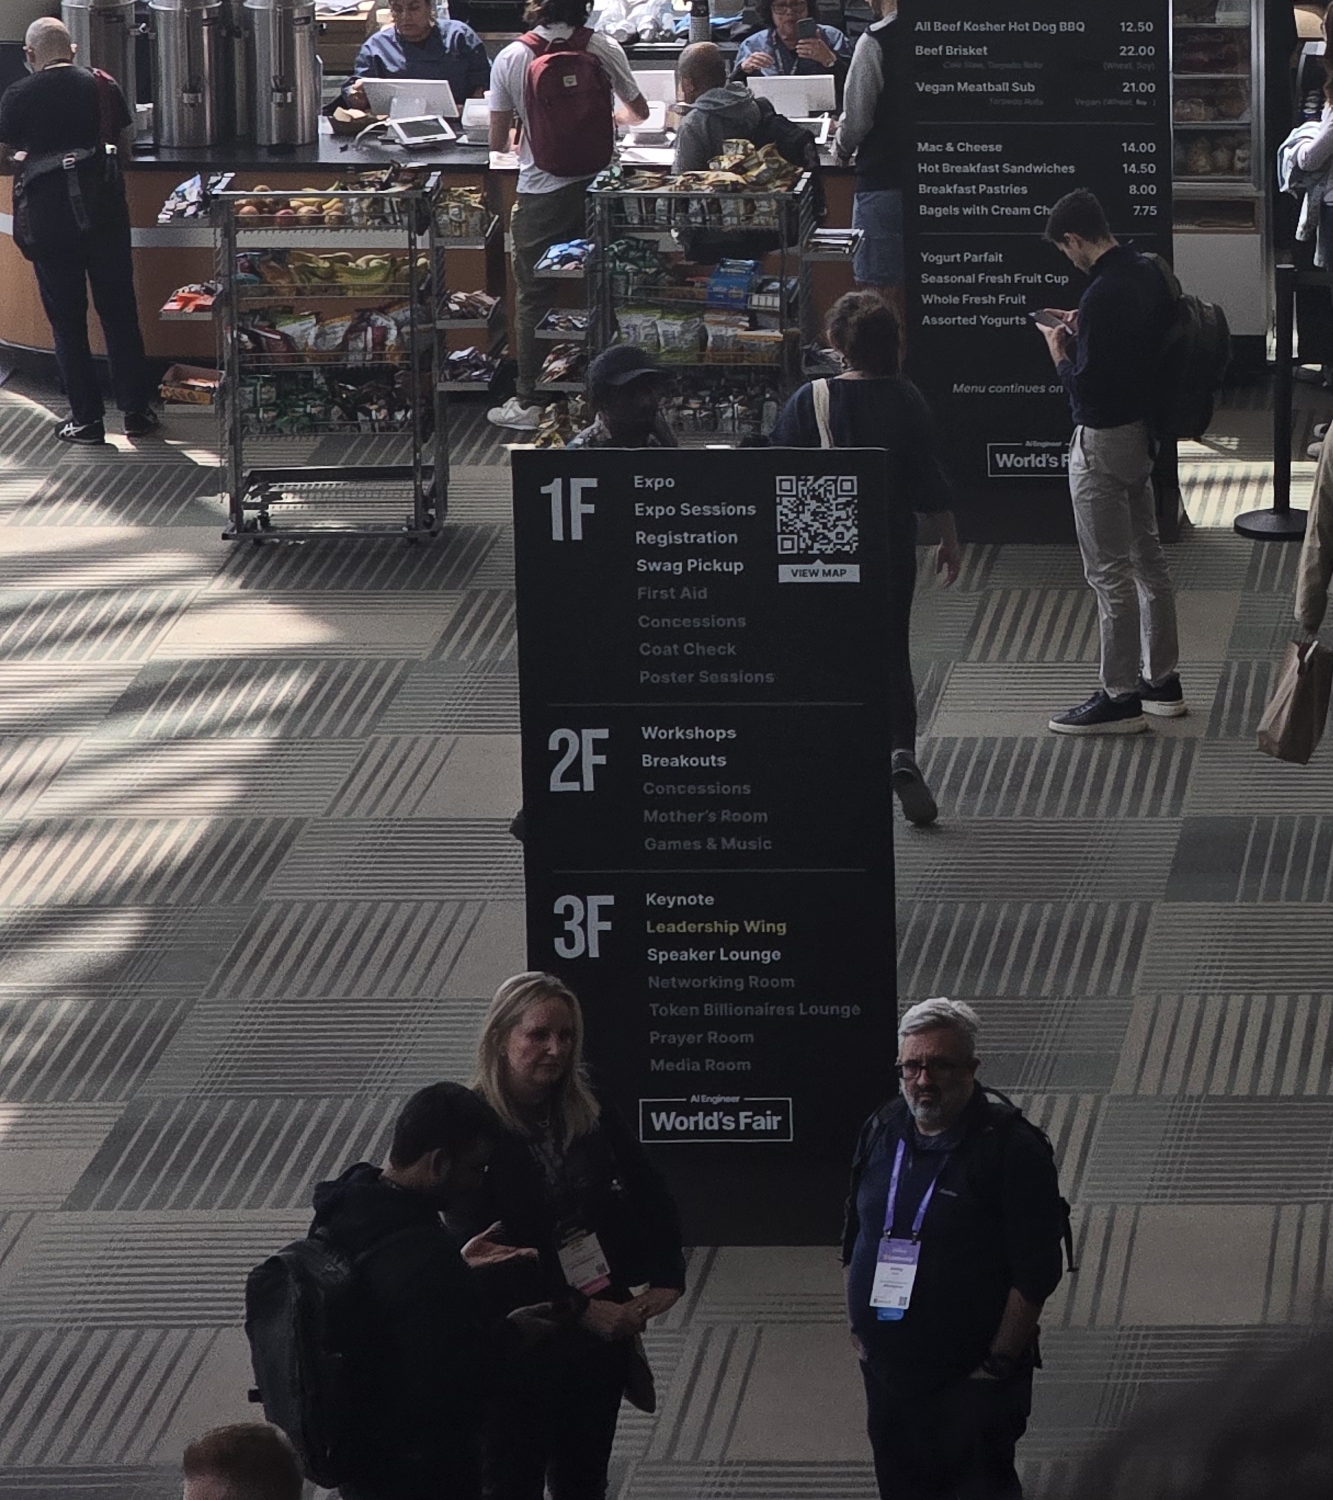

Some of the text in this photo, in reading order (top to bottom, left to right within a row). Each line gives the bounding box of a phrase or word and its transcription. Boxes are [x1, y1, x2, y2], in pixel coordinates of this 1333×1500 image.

[915, 21, 1085, 34] All Beef Kosher Hot Dog BBQ
[1120, 22, 1153, 32] 12.50
[916, 45, 987, 55] Beef Brisket
[1120, 46, 1155, 56] 22.00
[915, 82, 1035, 94] Vegan Meatball Sub
[1123, 82, 1155, 92] 21.00
[917, 142, 1002, 151] Mac & Cheese
[1122, 143, 1156, 152] 14.00
[918, 163, 1075, 173] Hot Breakfast Sandwiches
[1123, 164, 1156, 173] 14.50
[919, 184, 1027, 194] Breakfast Pastries
[1129, 185, 1156, 194] 8.00
[920, 205, 959, 217] Bagels
[962, 205, 988, 215] with
[991, 205, 1030, 215] Cream
[1133, 206, 1157, 215] 7.75
[921, 252, 1002, 264] Yogurt Parfait
[921, 273, 1069, 285] Seasonal Fresh Fruit Cup
[921, 294, 1026, 304] Whole Fresh Fruit
[922, 315, 1026, 327] Assorted Yogurts
[953, 383, 1063, 393] Menu continues on
[996, 454, 1058, 467] World's
[634, 476, 674, 490] Expo
[541, 478, 598, 541] 1F
[635, 502, 756, 519] Expo Sessions
[636, 531, 737, 547] Registration
[637, 558, 743, 575] Swag Pickup
[791, 569, 846, 577] VIEW MAP
[638, 587, 707, 600] First Aid
[638, 615, 746, 627] Concessions
[639, 643, 736, 655] Coat Check
[640, 670, 774, 683] Poster Sessions
[642, 726, 736, 741] Workshops
[549, 728, 609, 791] 2F
[642, 754, 726, 767] Breakouts
[643, 782, 751, 795] Concessions
[644, 809, 768, 823] Mother's Room
[645, 837, 772, 850] Games & Music
[647, 893, 714, 908] Keynote
[554, 895, 614, 958] 3F
[647, 920, 786, 936] Leadership Wing
[648, 948, 781, 964] Speaker Lounge
[648, 976, 795, 991] Networking Room
[649, 1002, 861, 1018] Token Billionaires Lounge
[650, 1031, 754, 1047] Prayer Room
[651, 1058, 751, 1071] Media Room
[651, 1111, 782, 1131] World's Fair
